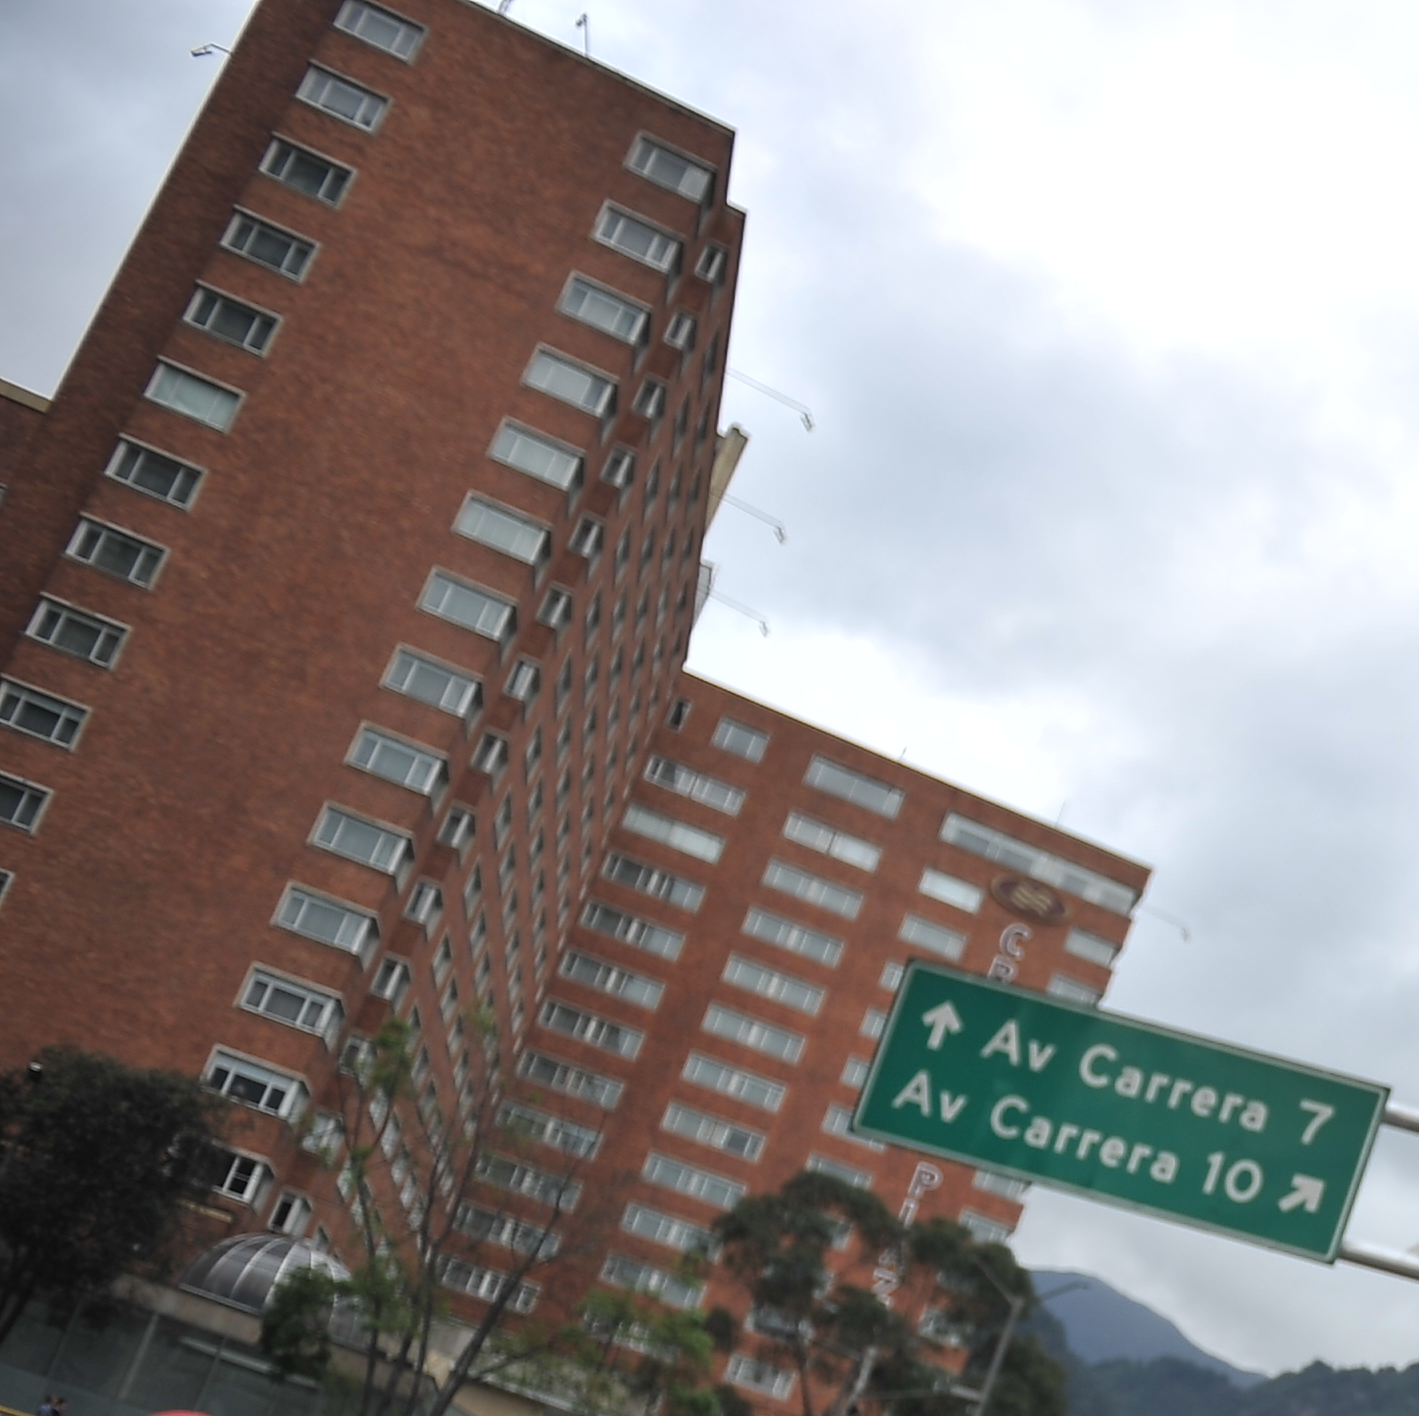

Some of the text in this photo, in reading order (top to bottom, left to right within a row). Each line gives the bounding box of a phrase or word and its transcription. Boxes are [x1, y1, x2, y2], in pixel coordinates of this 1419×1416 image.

[892, 1070, 1263, 1206] Av Carrera 10
[981, 1019, 1336, 1145] Av Carrera 7
